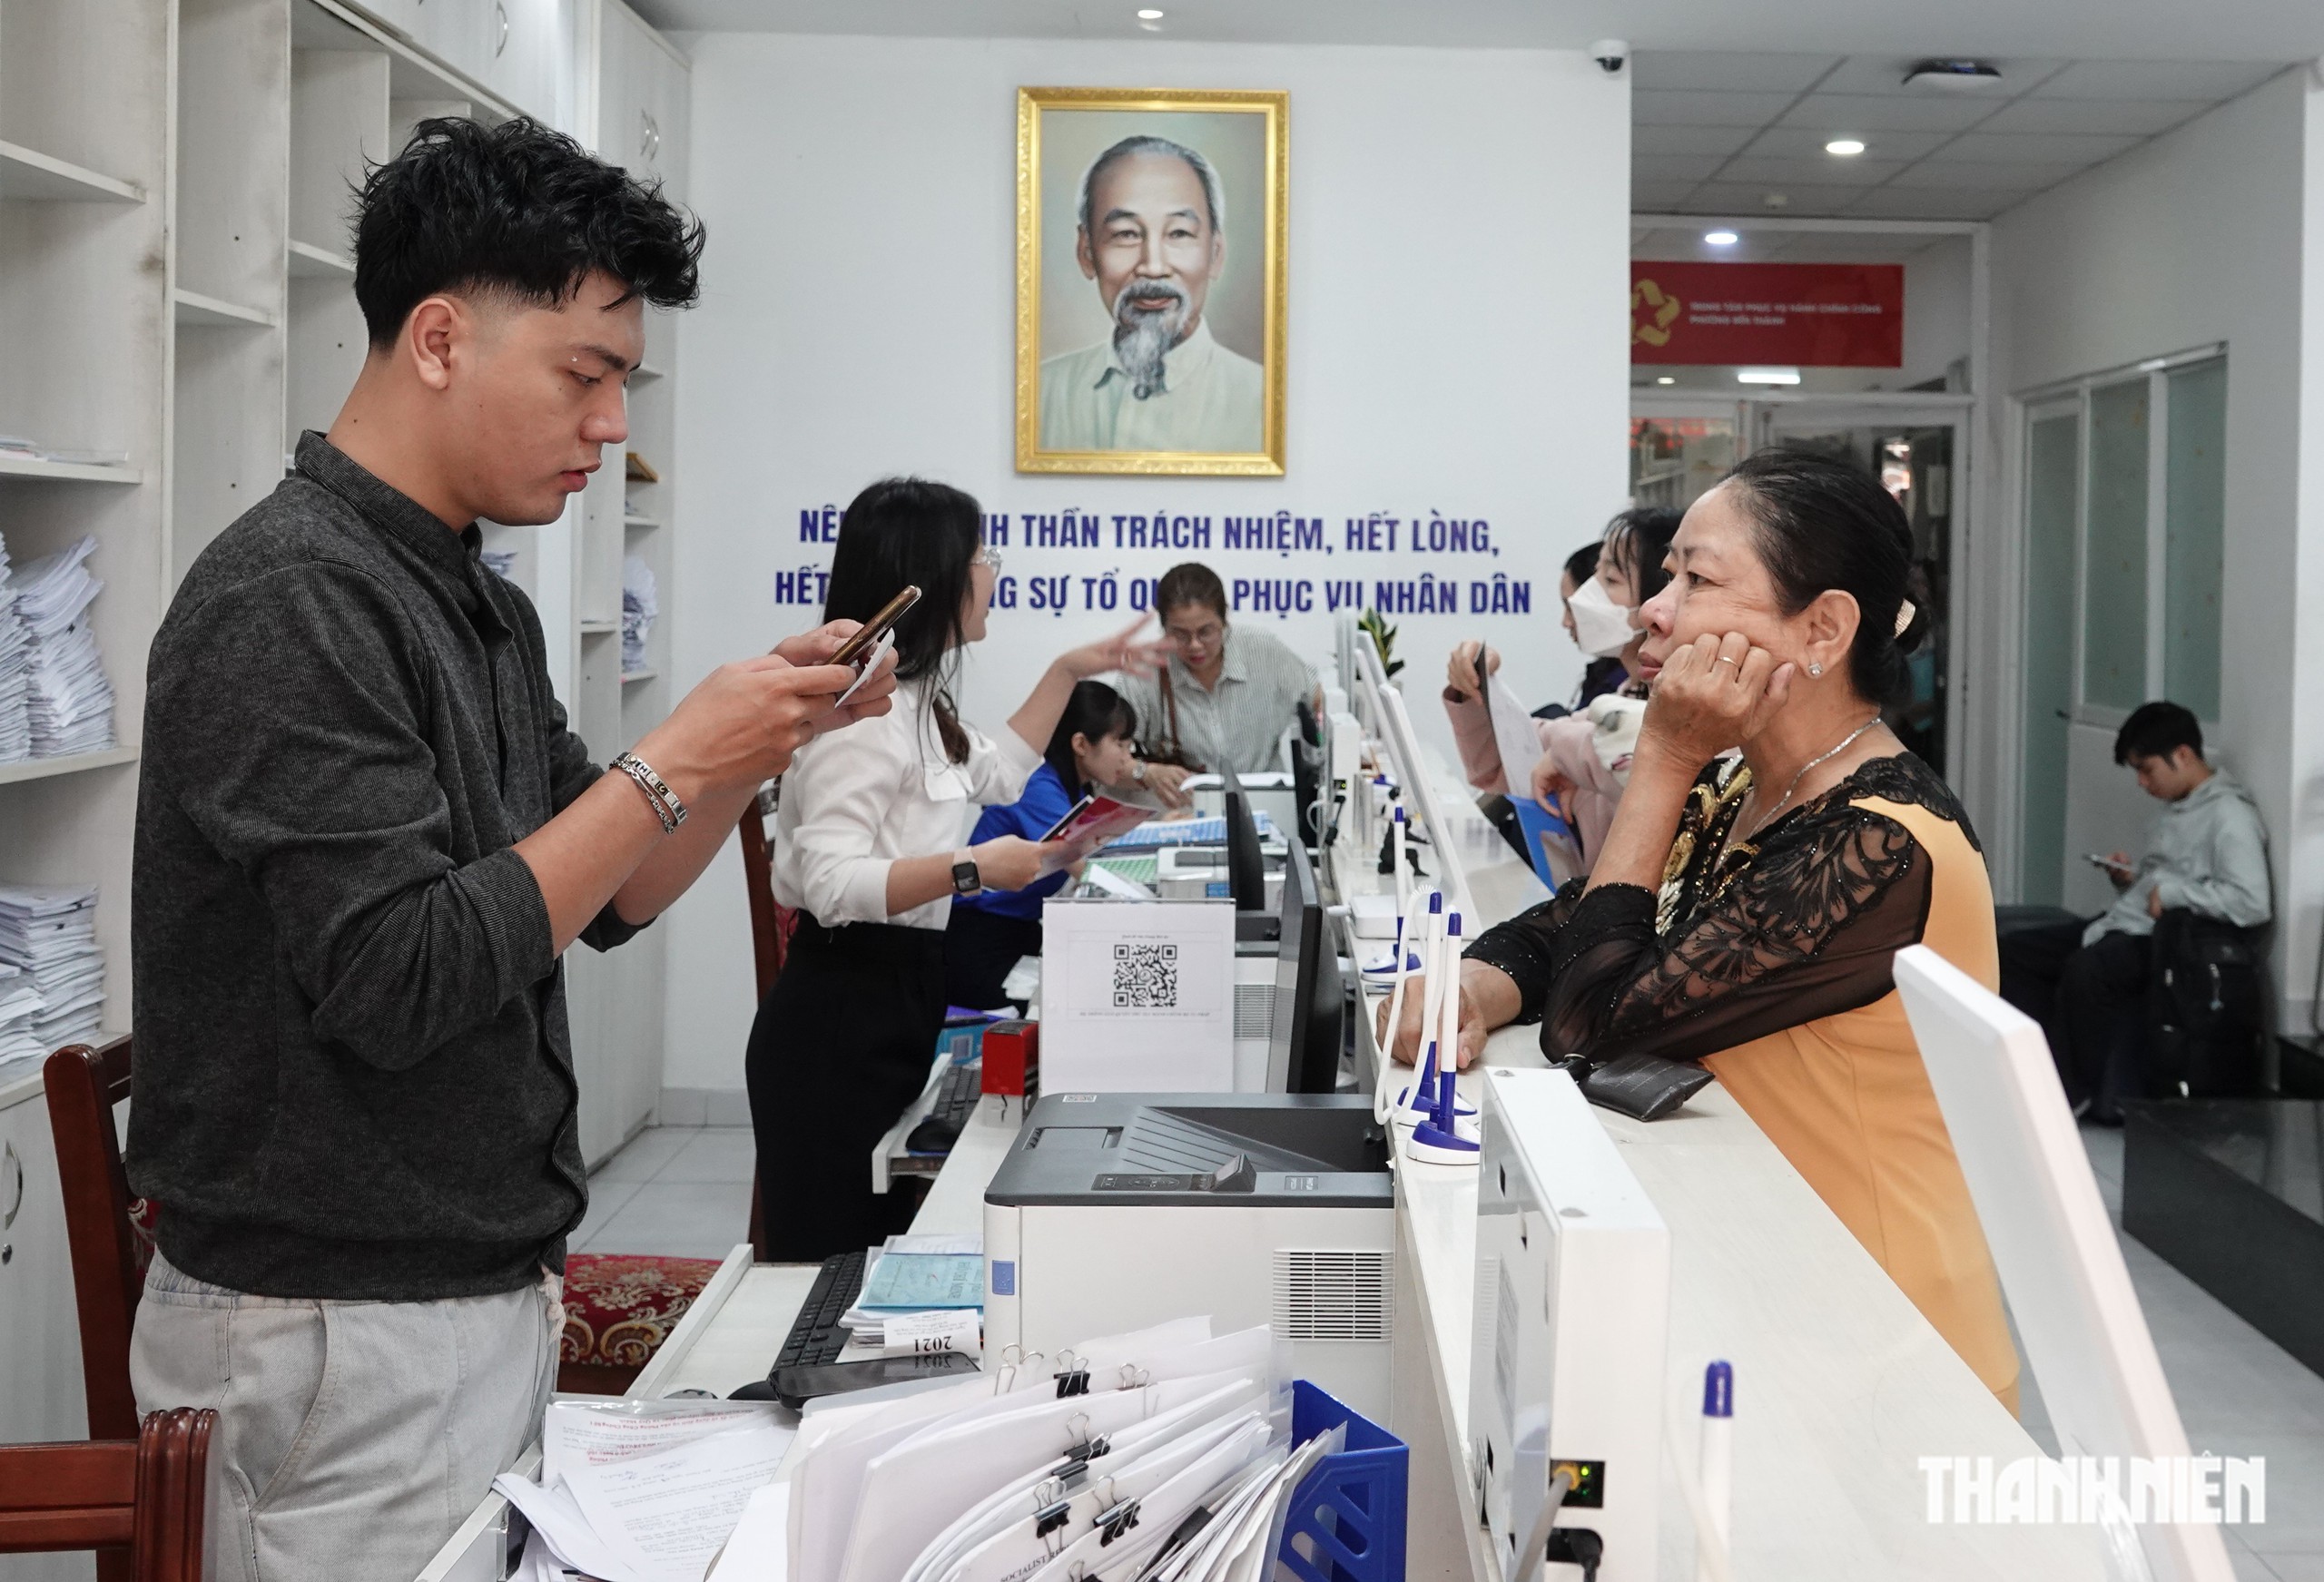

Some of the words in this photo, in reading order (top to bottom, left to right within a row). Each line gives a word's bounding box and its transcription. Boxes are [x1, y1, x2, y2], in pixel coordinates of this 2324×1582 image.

[1020, 506, 1099, 548] THẦN
[1110, 509, 1211, 549] TRÁCH
[1224, 510, 1334, 558] NHIỆM,
[1345, 510, 1400, 553] HẾT
[1412, 509, 1500, 557] LÒNG,
[775, 563, 832, 604] HẾT
[1029, 575, 1070, 618] SỰ
[1081, 567, 1119, 611] TỔ
[1232, 579, 1314, 620] PHỤC
[1375, 572, 1458, 614] NHÂN
[1470, 572, 1531, 615] DÂN
[914, 1335, 952, 1352] 2021
[1000, 1555, 1047, 1582] SOCIALIST
